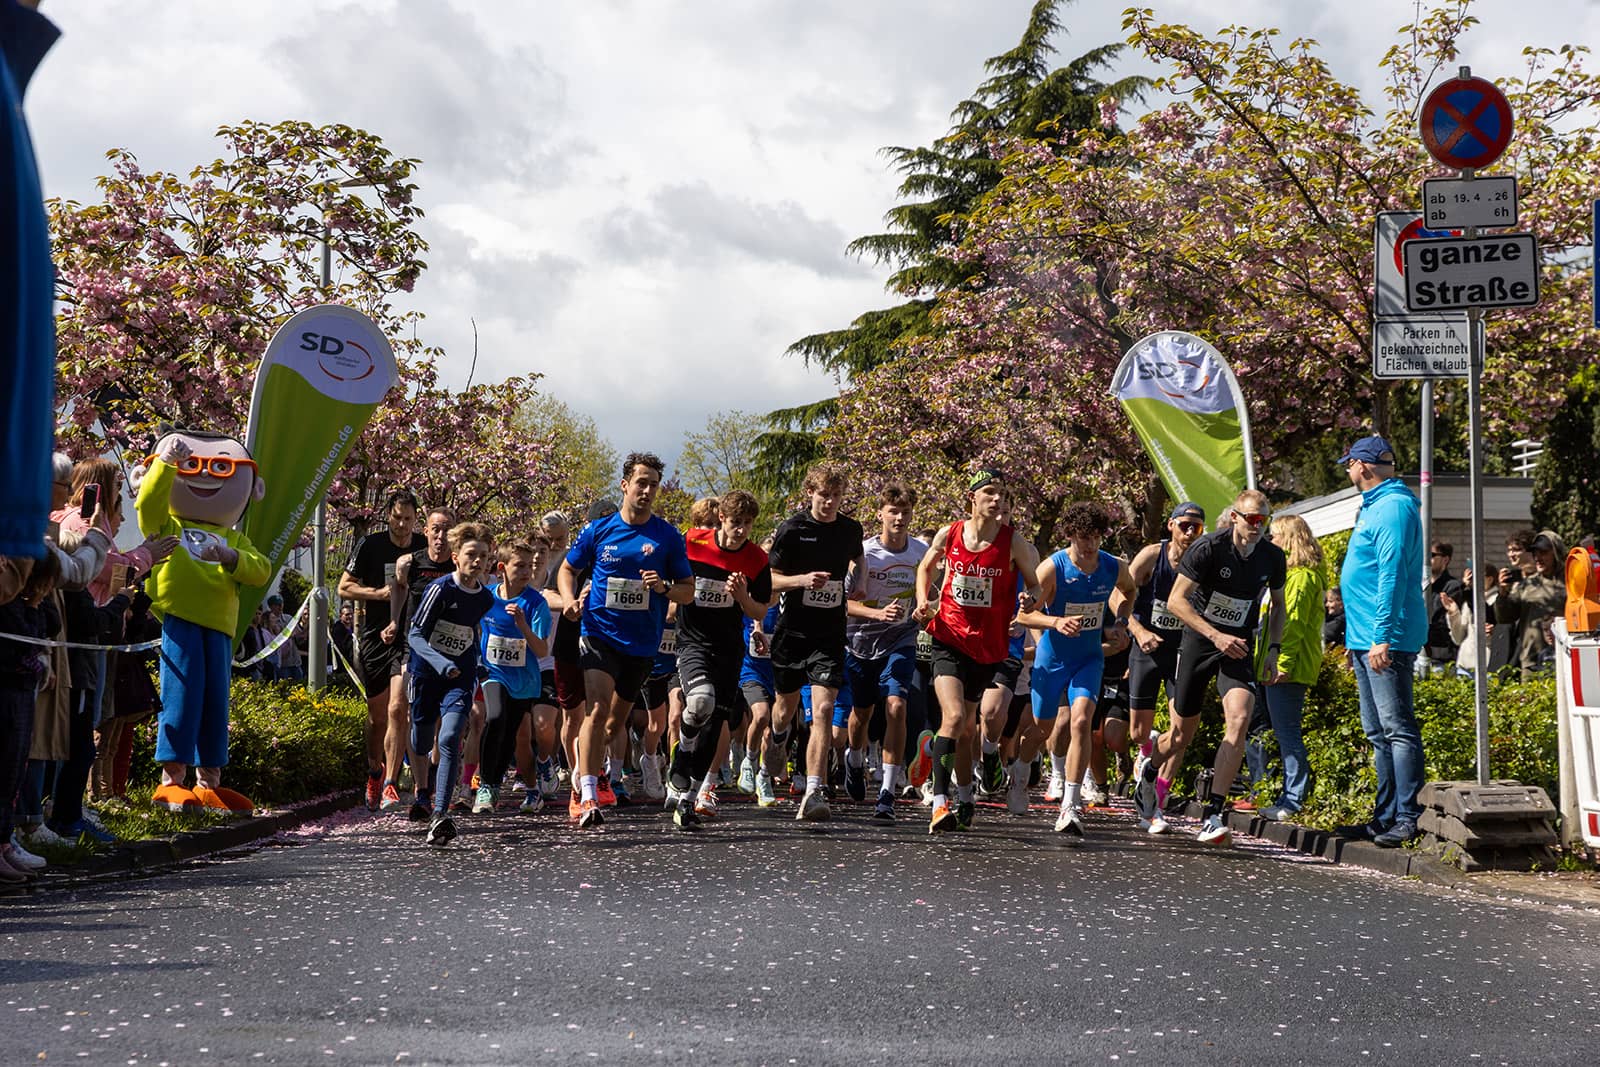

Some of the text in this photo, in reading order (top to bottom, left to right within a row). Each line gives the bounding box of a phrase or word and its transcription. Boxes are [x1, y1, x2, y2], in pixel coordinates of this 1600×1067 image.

[1430, 193, 1446, 204] ab
[1431, 207, 1509, 220] ab 6h
[1419, 242, 1521, 273] ganze
[1415, 276, 1530, 306] Straße
[1403, 326, 1456, 339] Parken in
[300, 332, 344, 355] SD
[1386, 358, 1468, 371] Flächen erlaub
[949, 559, 1003, 579] LG Alpen
[613, 591, 643, 605] 1669
[699, 591, 728, 603] 3281
[809, 591, 837, 603] 3294
[956, 587, 985, 601] 2614
[1212, 606, 1242, 622] 2860
[436, 634, 466, 651] 2855
[492, 648, 520, 661] 1784
